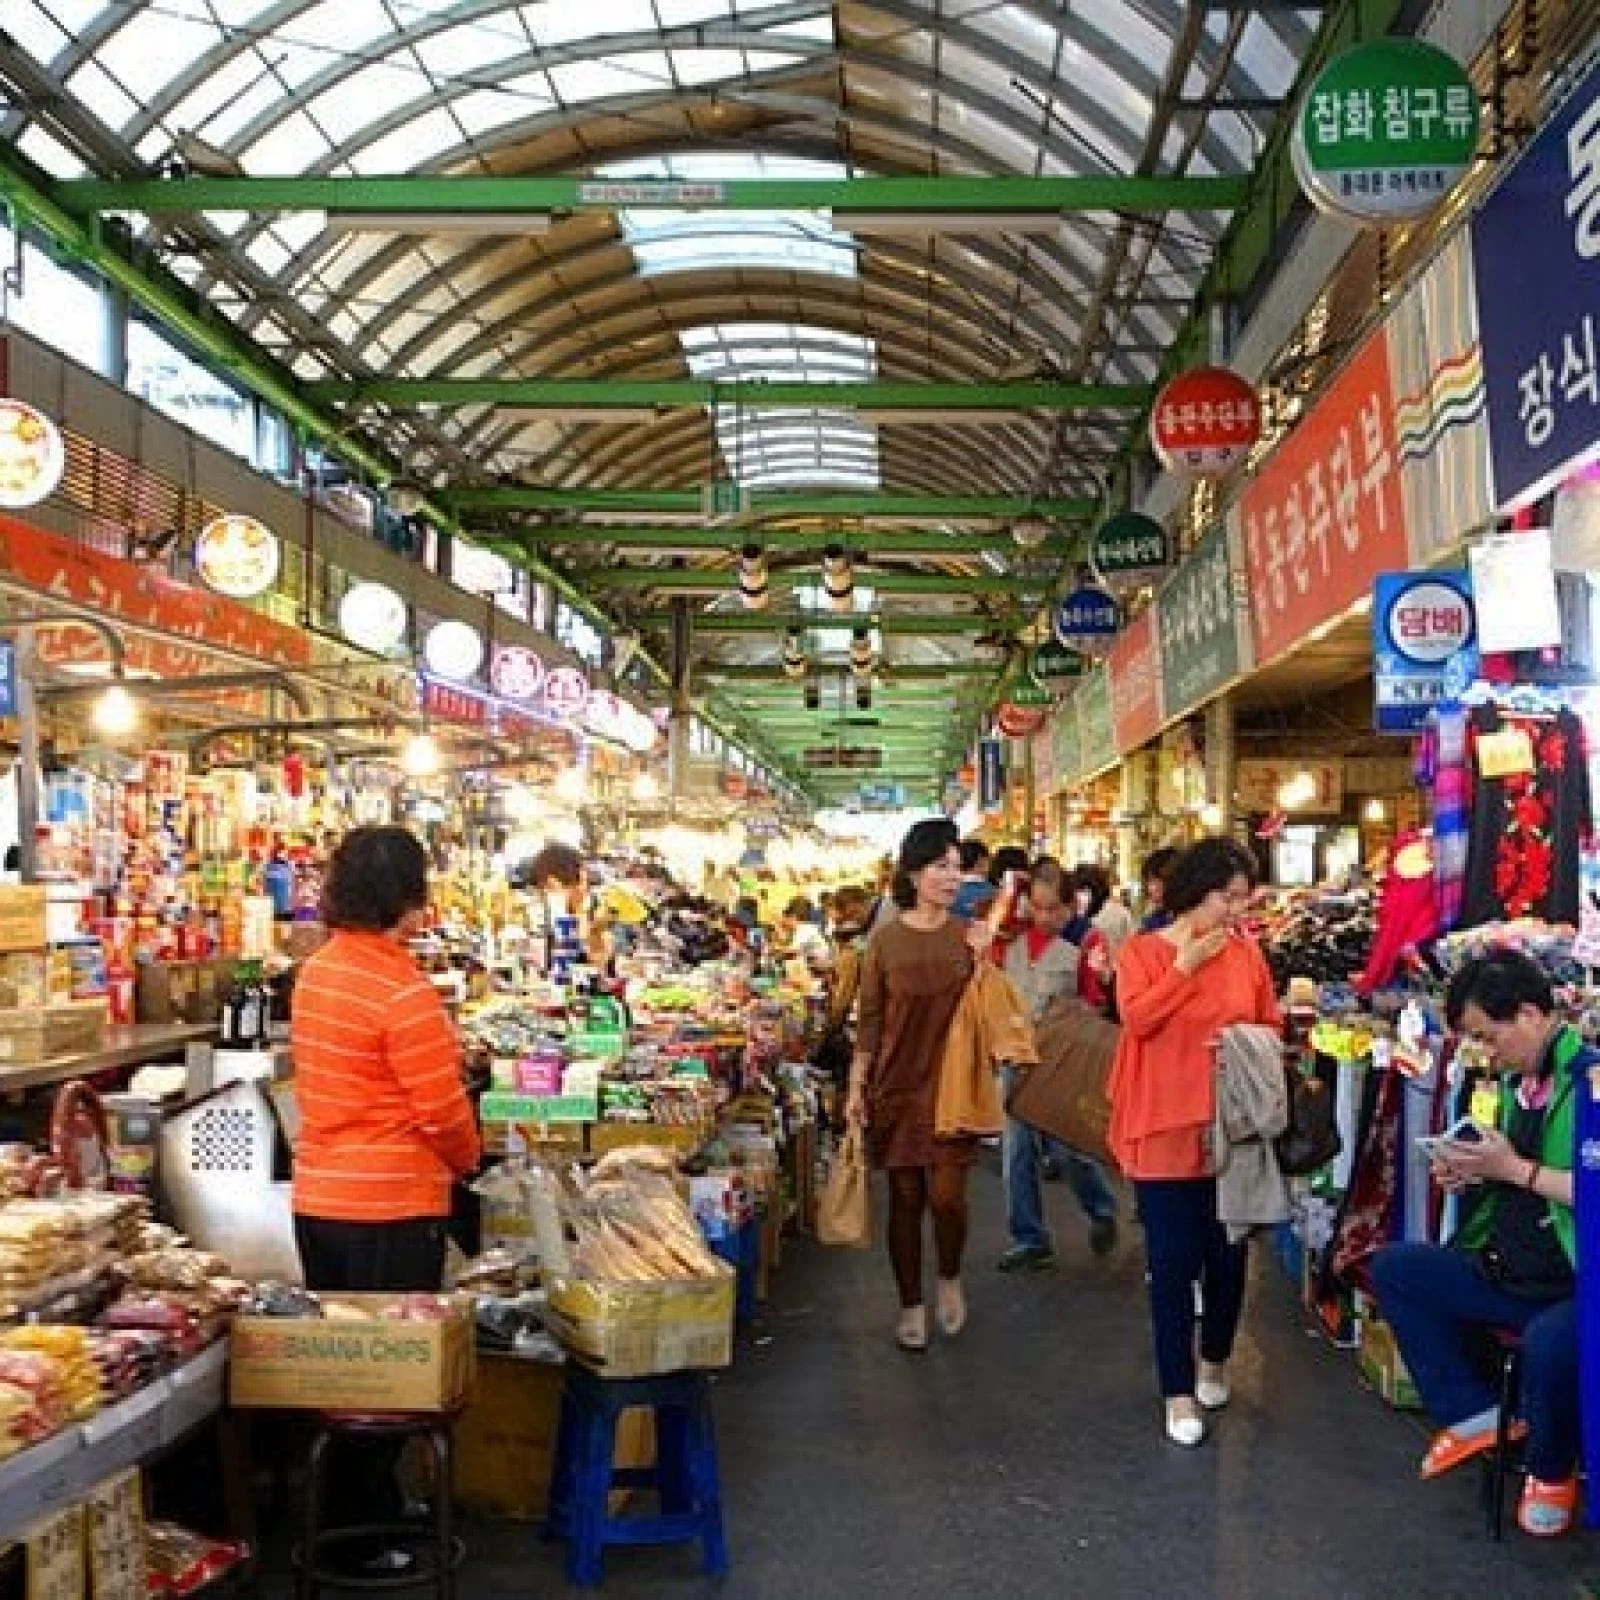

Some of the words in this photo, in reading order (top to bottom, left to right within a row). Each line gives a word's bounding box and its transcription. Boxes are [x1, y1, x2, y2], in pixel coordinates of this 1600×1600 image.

[1382, 84, 1473, 141] 침구류
[1397, 606, 1463, 637] 담배
[286, 1335, 364, 1362] BANANA
[369, 1336, 432, 1364] CHIPS
